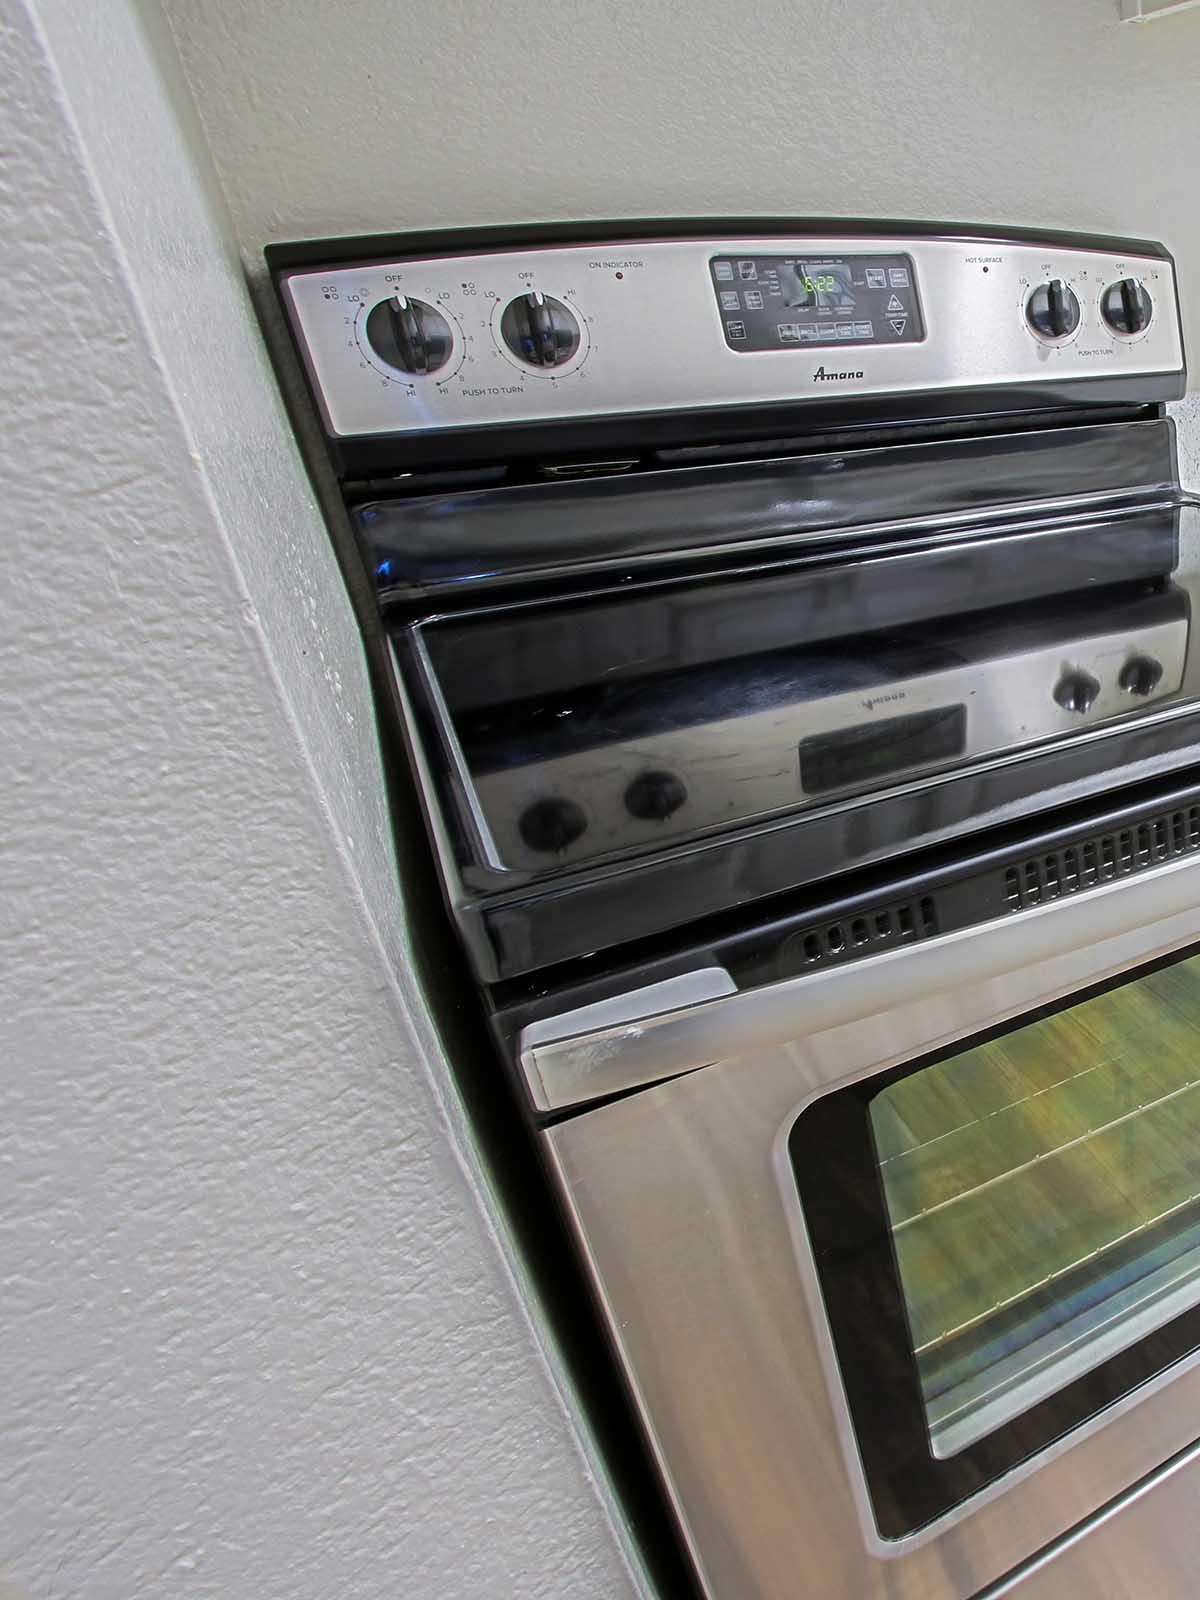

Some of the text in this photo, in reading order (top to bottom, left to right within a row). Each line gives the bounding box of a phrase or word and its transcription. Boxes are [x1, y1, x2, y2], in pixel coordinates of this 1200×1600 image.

[813, 366, 864, 382] Amana
[462, 386, 524, 397] PUSH TO TURN
